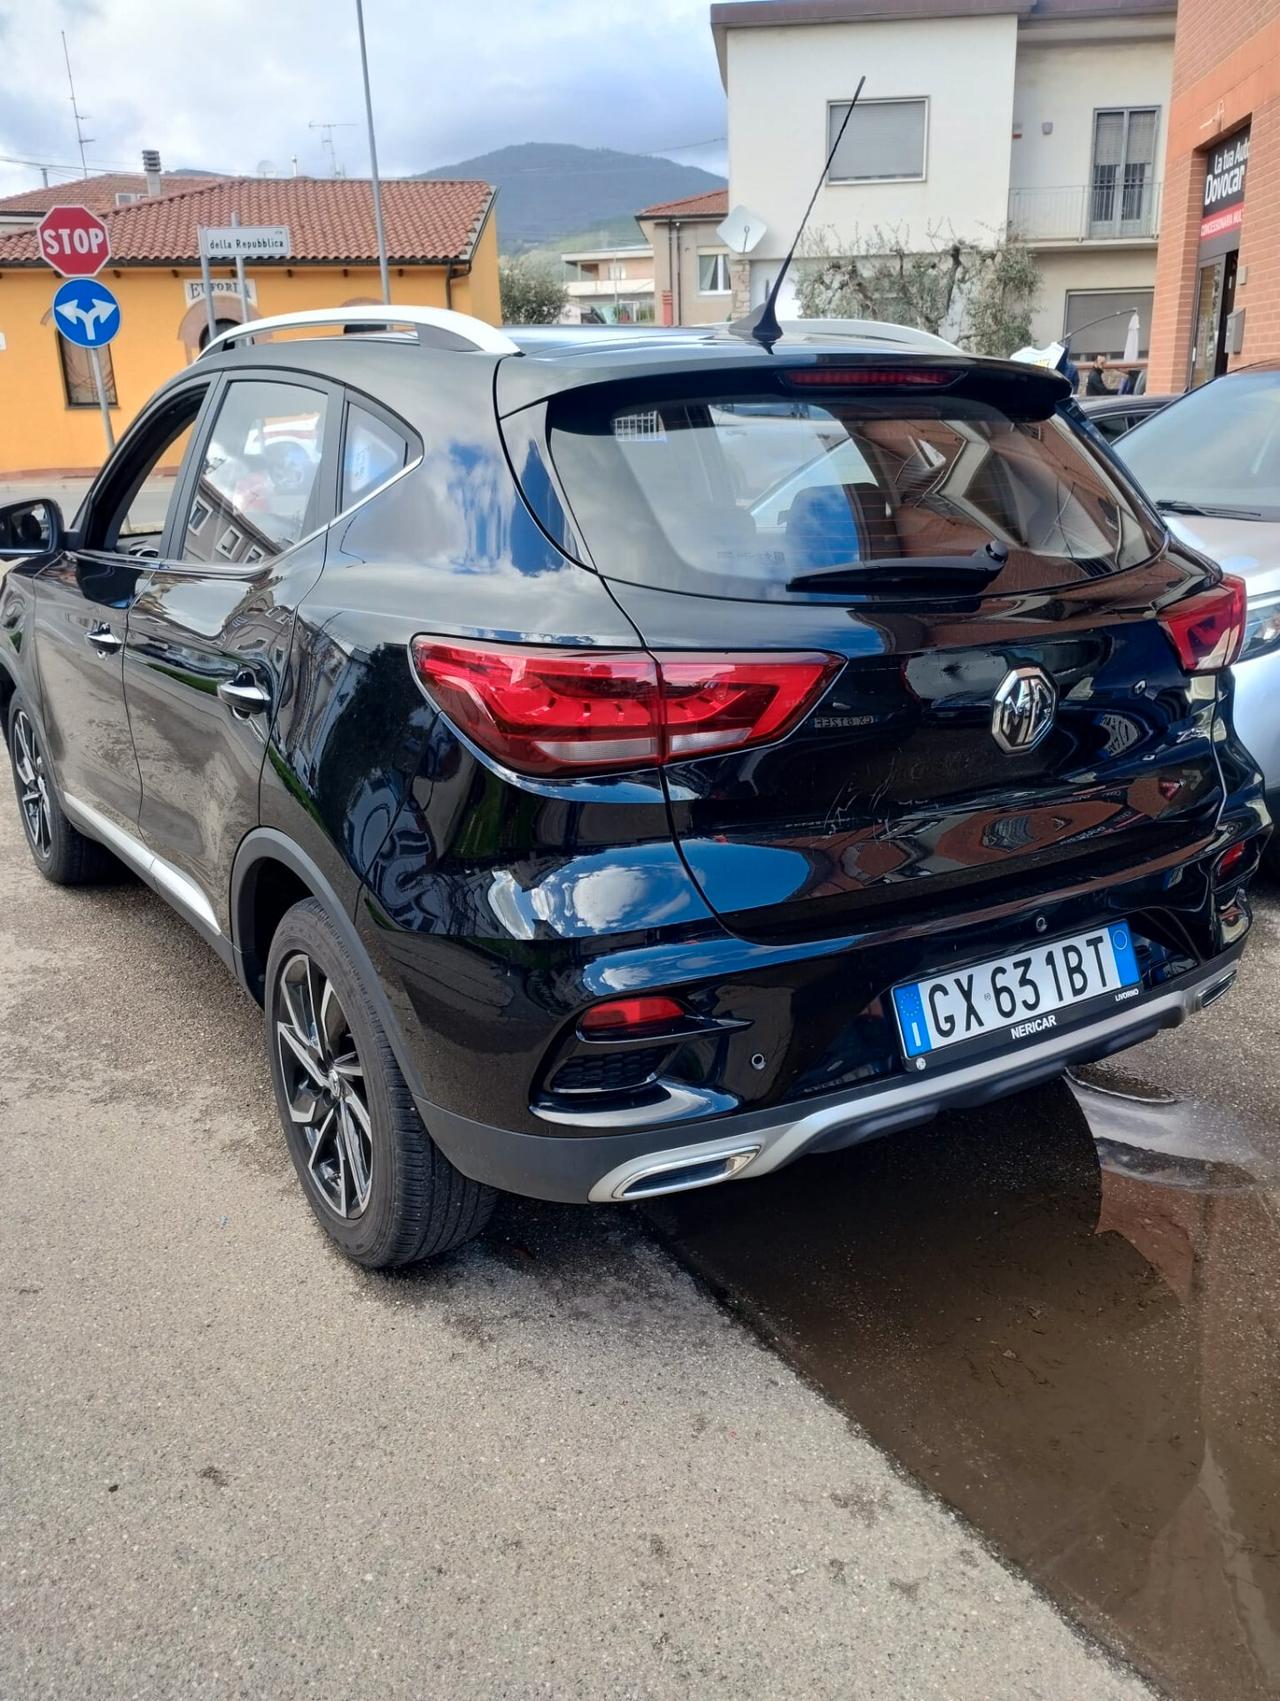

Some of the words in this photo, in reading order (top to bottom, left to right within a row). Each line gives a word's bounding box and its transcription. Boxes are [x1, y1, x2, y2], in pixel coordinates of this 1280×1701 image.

[1204, 165, 1245, 206] Dovocar
[43, 228, 104, 255] STOP
[210, 240, 232, 250] della
[236, 238, 284, 249] Repubblica
[1001, 678, 1052, 746] MG
[928, 974, 985, 1038] GX
[1114, 988, 1140, 1002] LIVORNO
[1010, 1014, 1057, 1039] NERICAR
